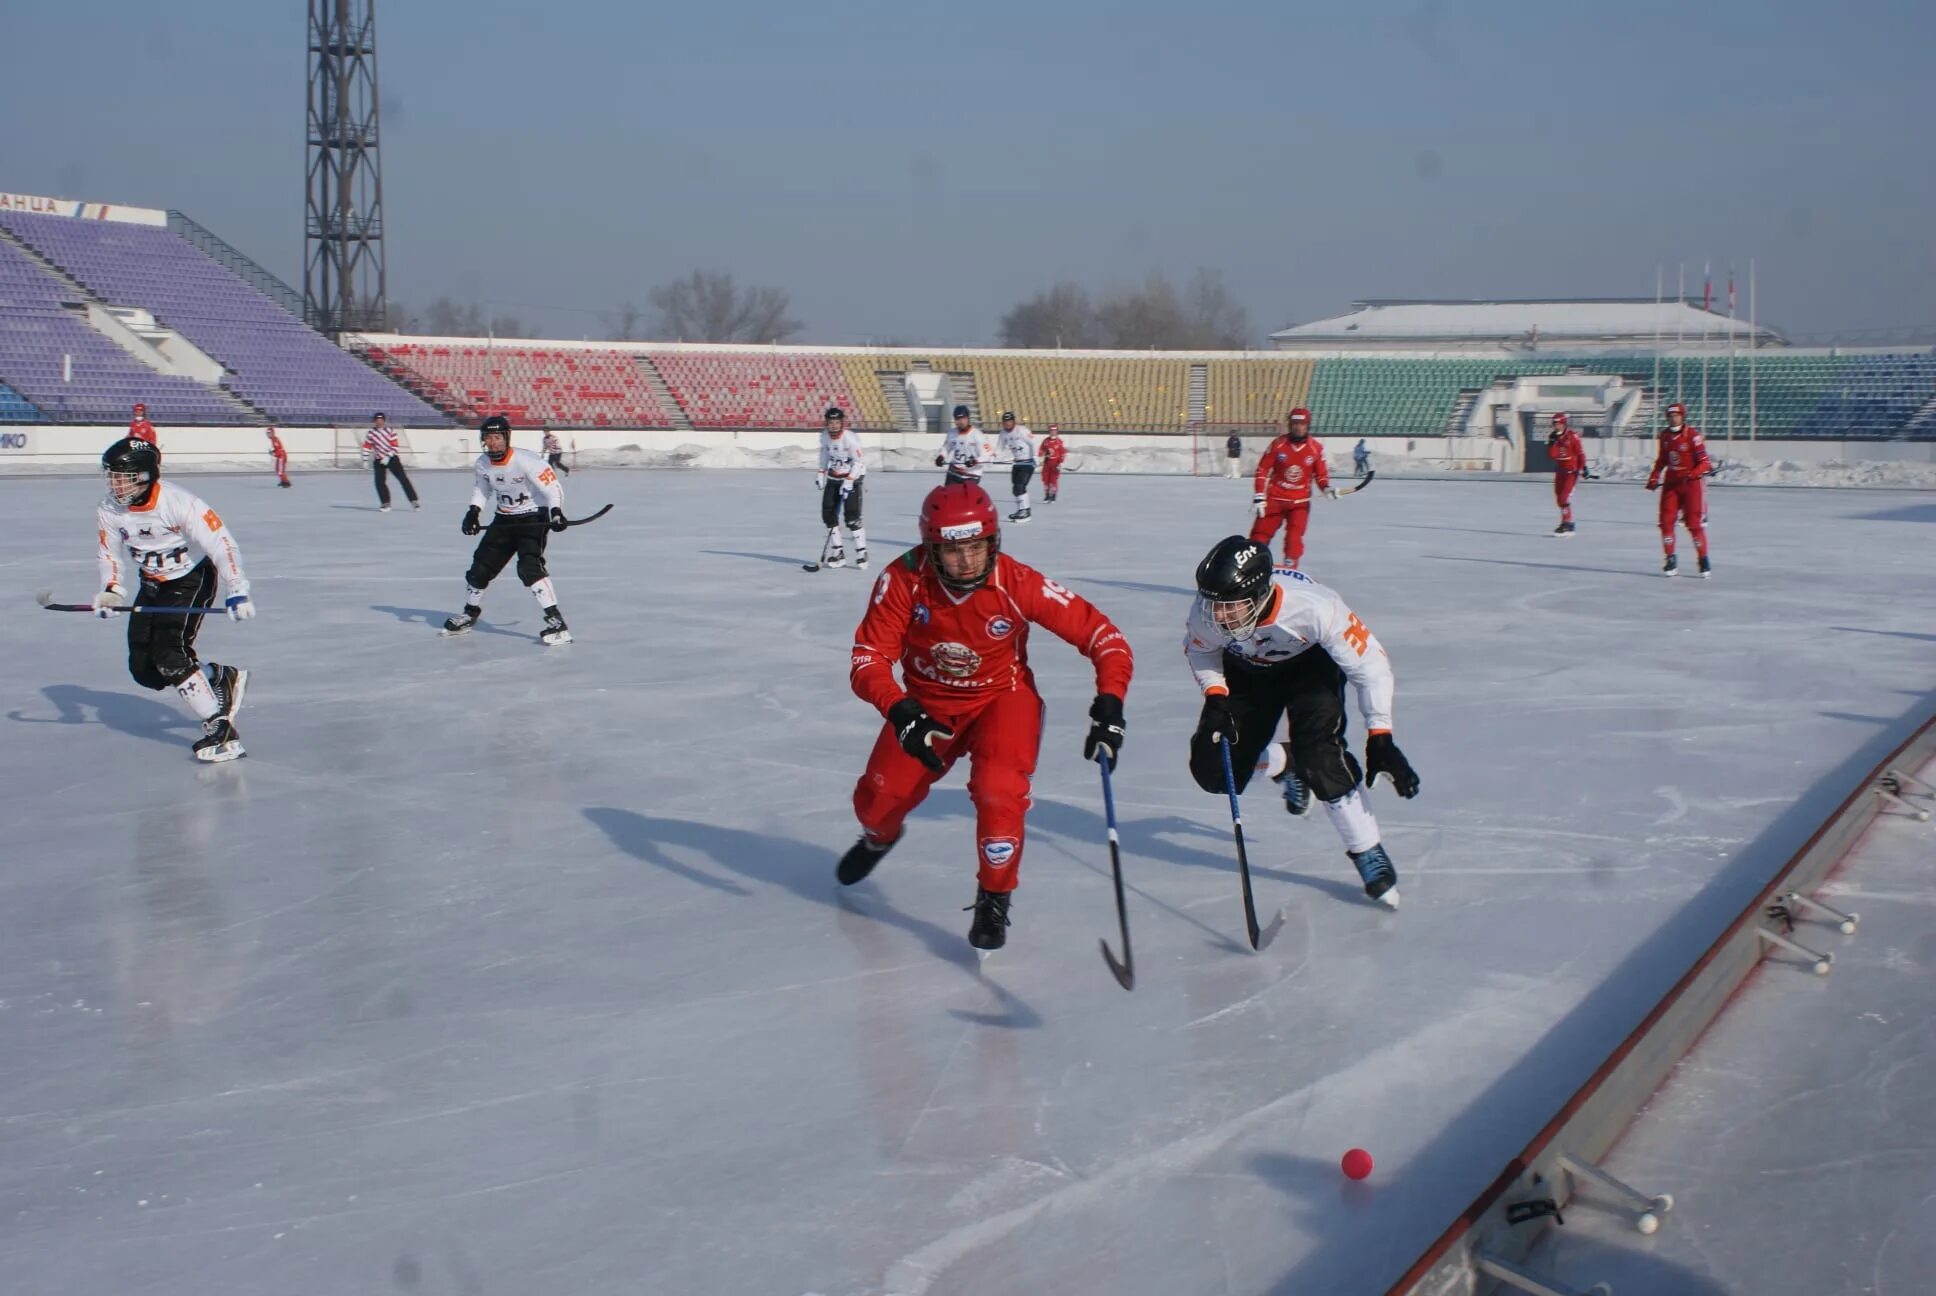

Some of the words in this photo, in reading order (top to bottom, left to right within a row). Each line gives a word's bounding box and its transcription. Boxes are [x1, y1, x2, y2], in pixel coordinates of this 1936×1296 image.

[538, 468, 557, 487] 95
[1235, 545, 1258, 565] En+
[1041, 578, 1075, 608] 19
